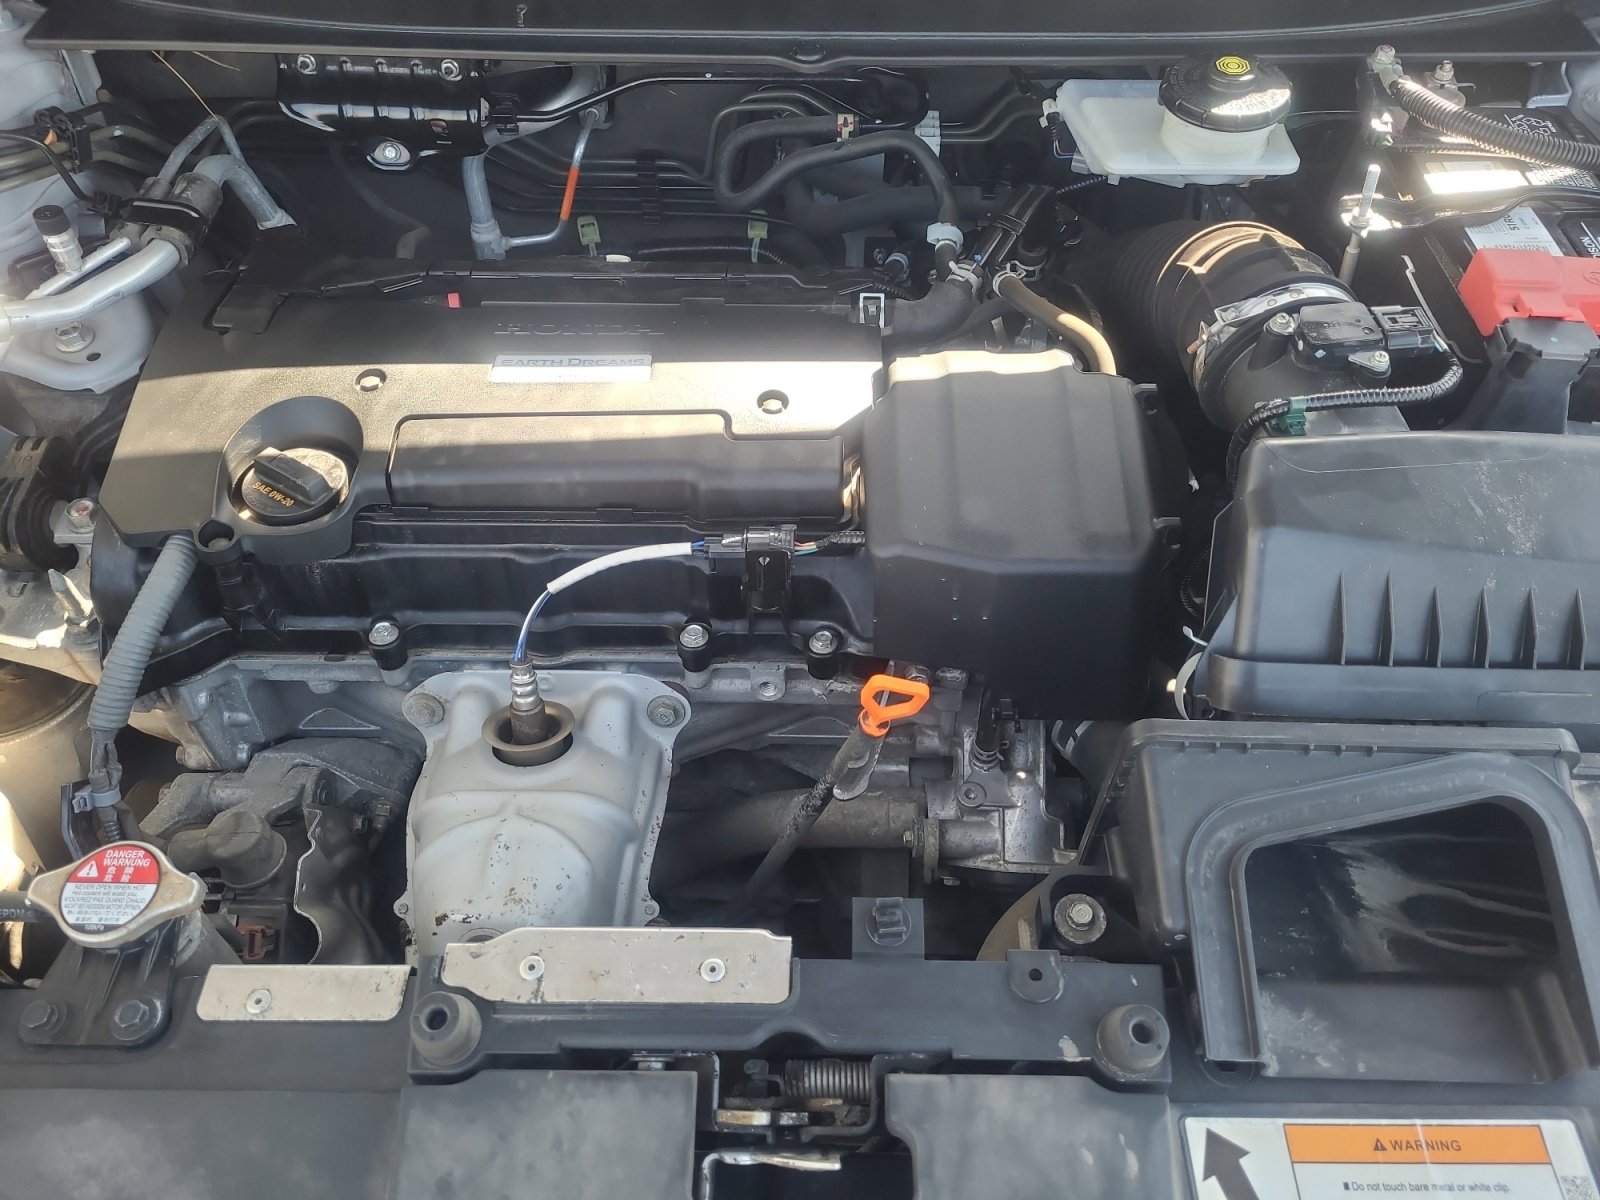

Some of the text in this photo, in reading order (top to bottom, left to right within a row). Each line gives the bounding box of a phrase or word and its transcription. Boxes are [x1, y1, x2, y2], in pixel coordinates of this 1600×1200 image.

[1579, 236, 1600, 259] OISON
[501, 358, 646, 367] EARTH DREAMS
[252, 481, 295, 507] SAE 0W-20
[105, 849, 146, 859] DANGER
[103, 858, 151, 867] WARNUNG
[1388, 1139, 1462, 1152] WARNING
[1351, 1181, 1365, 1191] Do
[1366, 1181, 1381, 1191] not
[1382, 1181, 1407, 1191] touch
[1408, 1181, 1429, 1191] bare
[1456, 1184, 1466, 1192] or
[1467, 1182, 1491, 1192] white
